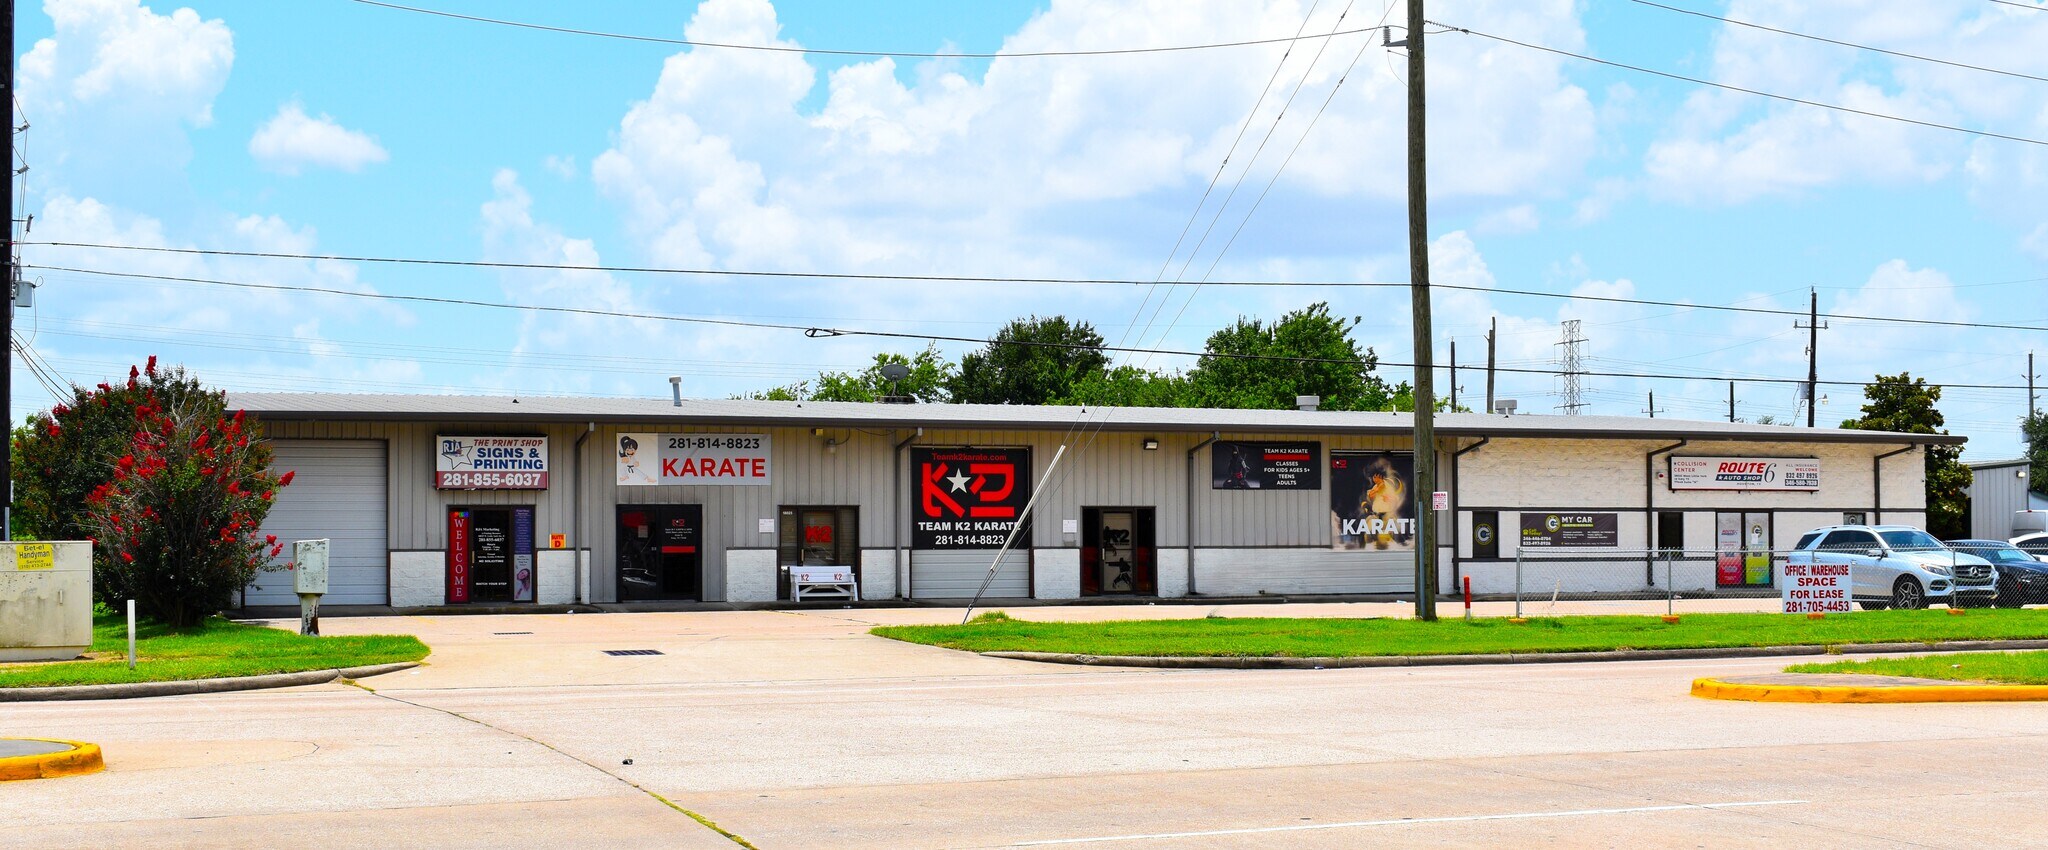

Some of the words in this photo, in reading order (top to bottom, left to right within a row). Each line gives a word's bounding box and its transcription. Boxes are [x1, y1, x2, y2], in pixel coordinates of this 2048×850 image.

[492, 439, 519, 447] PRINT
[521, 439, 543, 447] SHOP
[669, 438, 760, 449] 281-814-8823
[477, 448, 524, 458] SIGNS
[529, 448, 540, 458] &
[473, 459, 544, 470] PRINTING
[662, 458, 766, 477] KARATE
[1718, 462, 1767, 474] ROUTE
[1764, 463, 1777, 483] 6
[443, 473, 541, 486] 281-855-6037
[918, 521, 951, 531] TEAM
[955, 521, 971, 531] K2
[1342, 518, 1415, 535] KARATE
[805, 524, 833, 544] K2
[554, 540, 561, 548] D
[935, 535, 1005, 545] 281-814-8823
[19, 550, 51, 560] Handyman
[454, 518, 465, 597] WELCOME
[1785, 565, 1807, 576] OFFICE
[1811, 565, 1849, 576] WAREHOUSE
[800, 573, 810, 582] K2
[833, 573, 843, 581] K2
[1797, 577, 1837, 587] SPACE
[1790, 590, 1810, 599] FOR
[1813, 589, 1844, 599] LEASE
[1786, 601, 1850, 613] 281-705-4453
